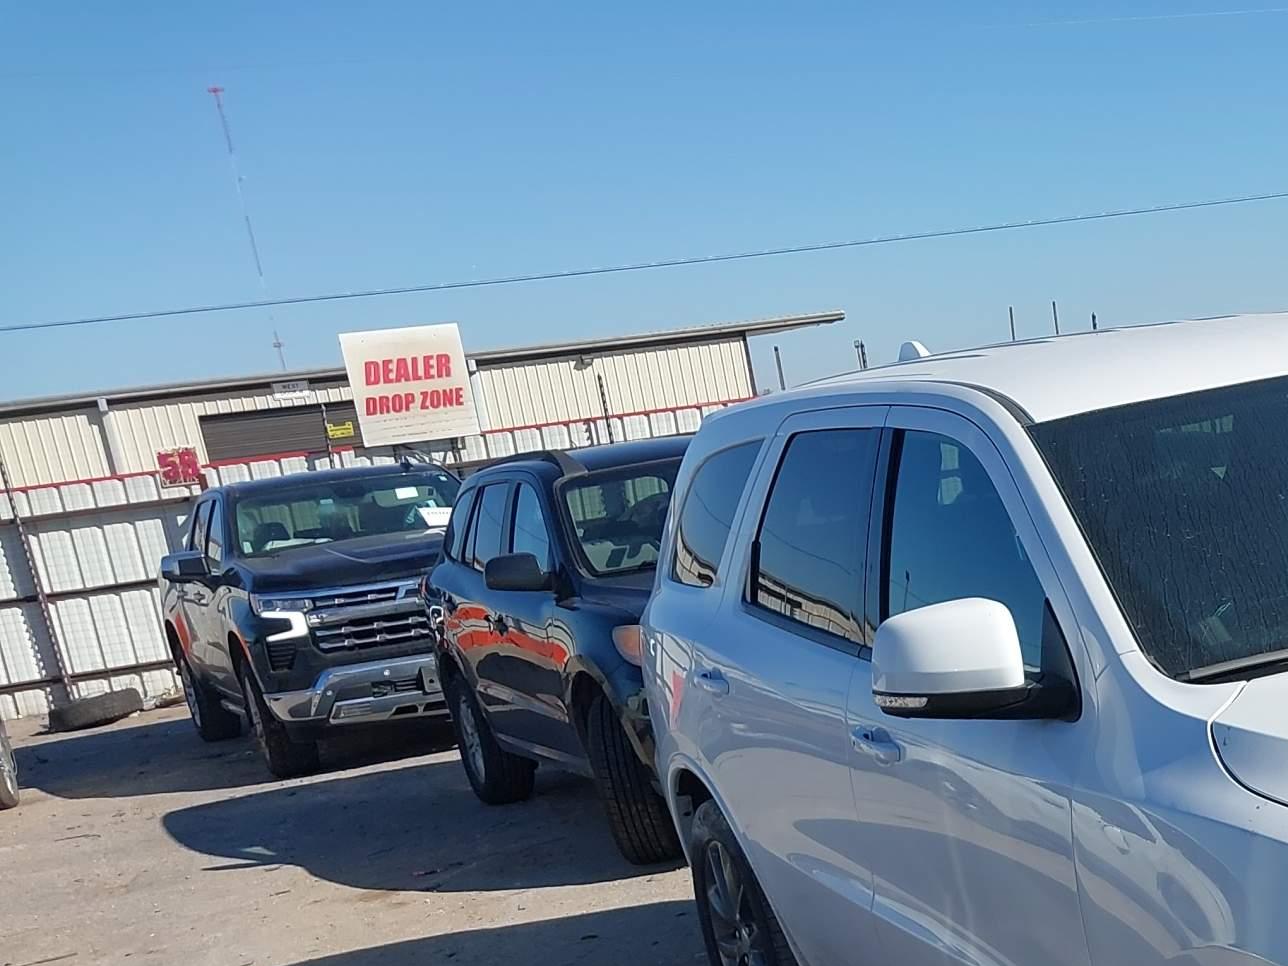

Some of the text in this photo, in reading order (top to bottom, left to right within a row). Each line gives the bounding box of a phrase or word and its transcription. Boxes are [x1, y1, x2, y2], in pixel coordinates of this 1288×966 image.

[364, 353, 452, 386] DEALER
[365, 387, 464, 416] DROP ZONE
[157, 449, 199, 481] 58
